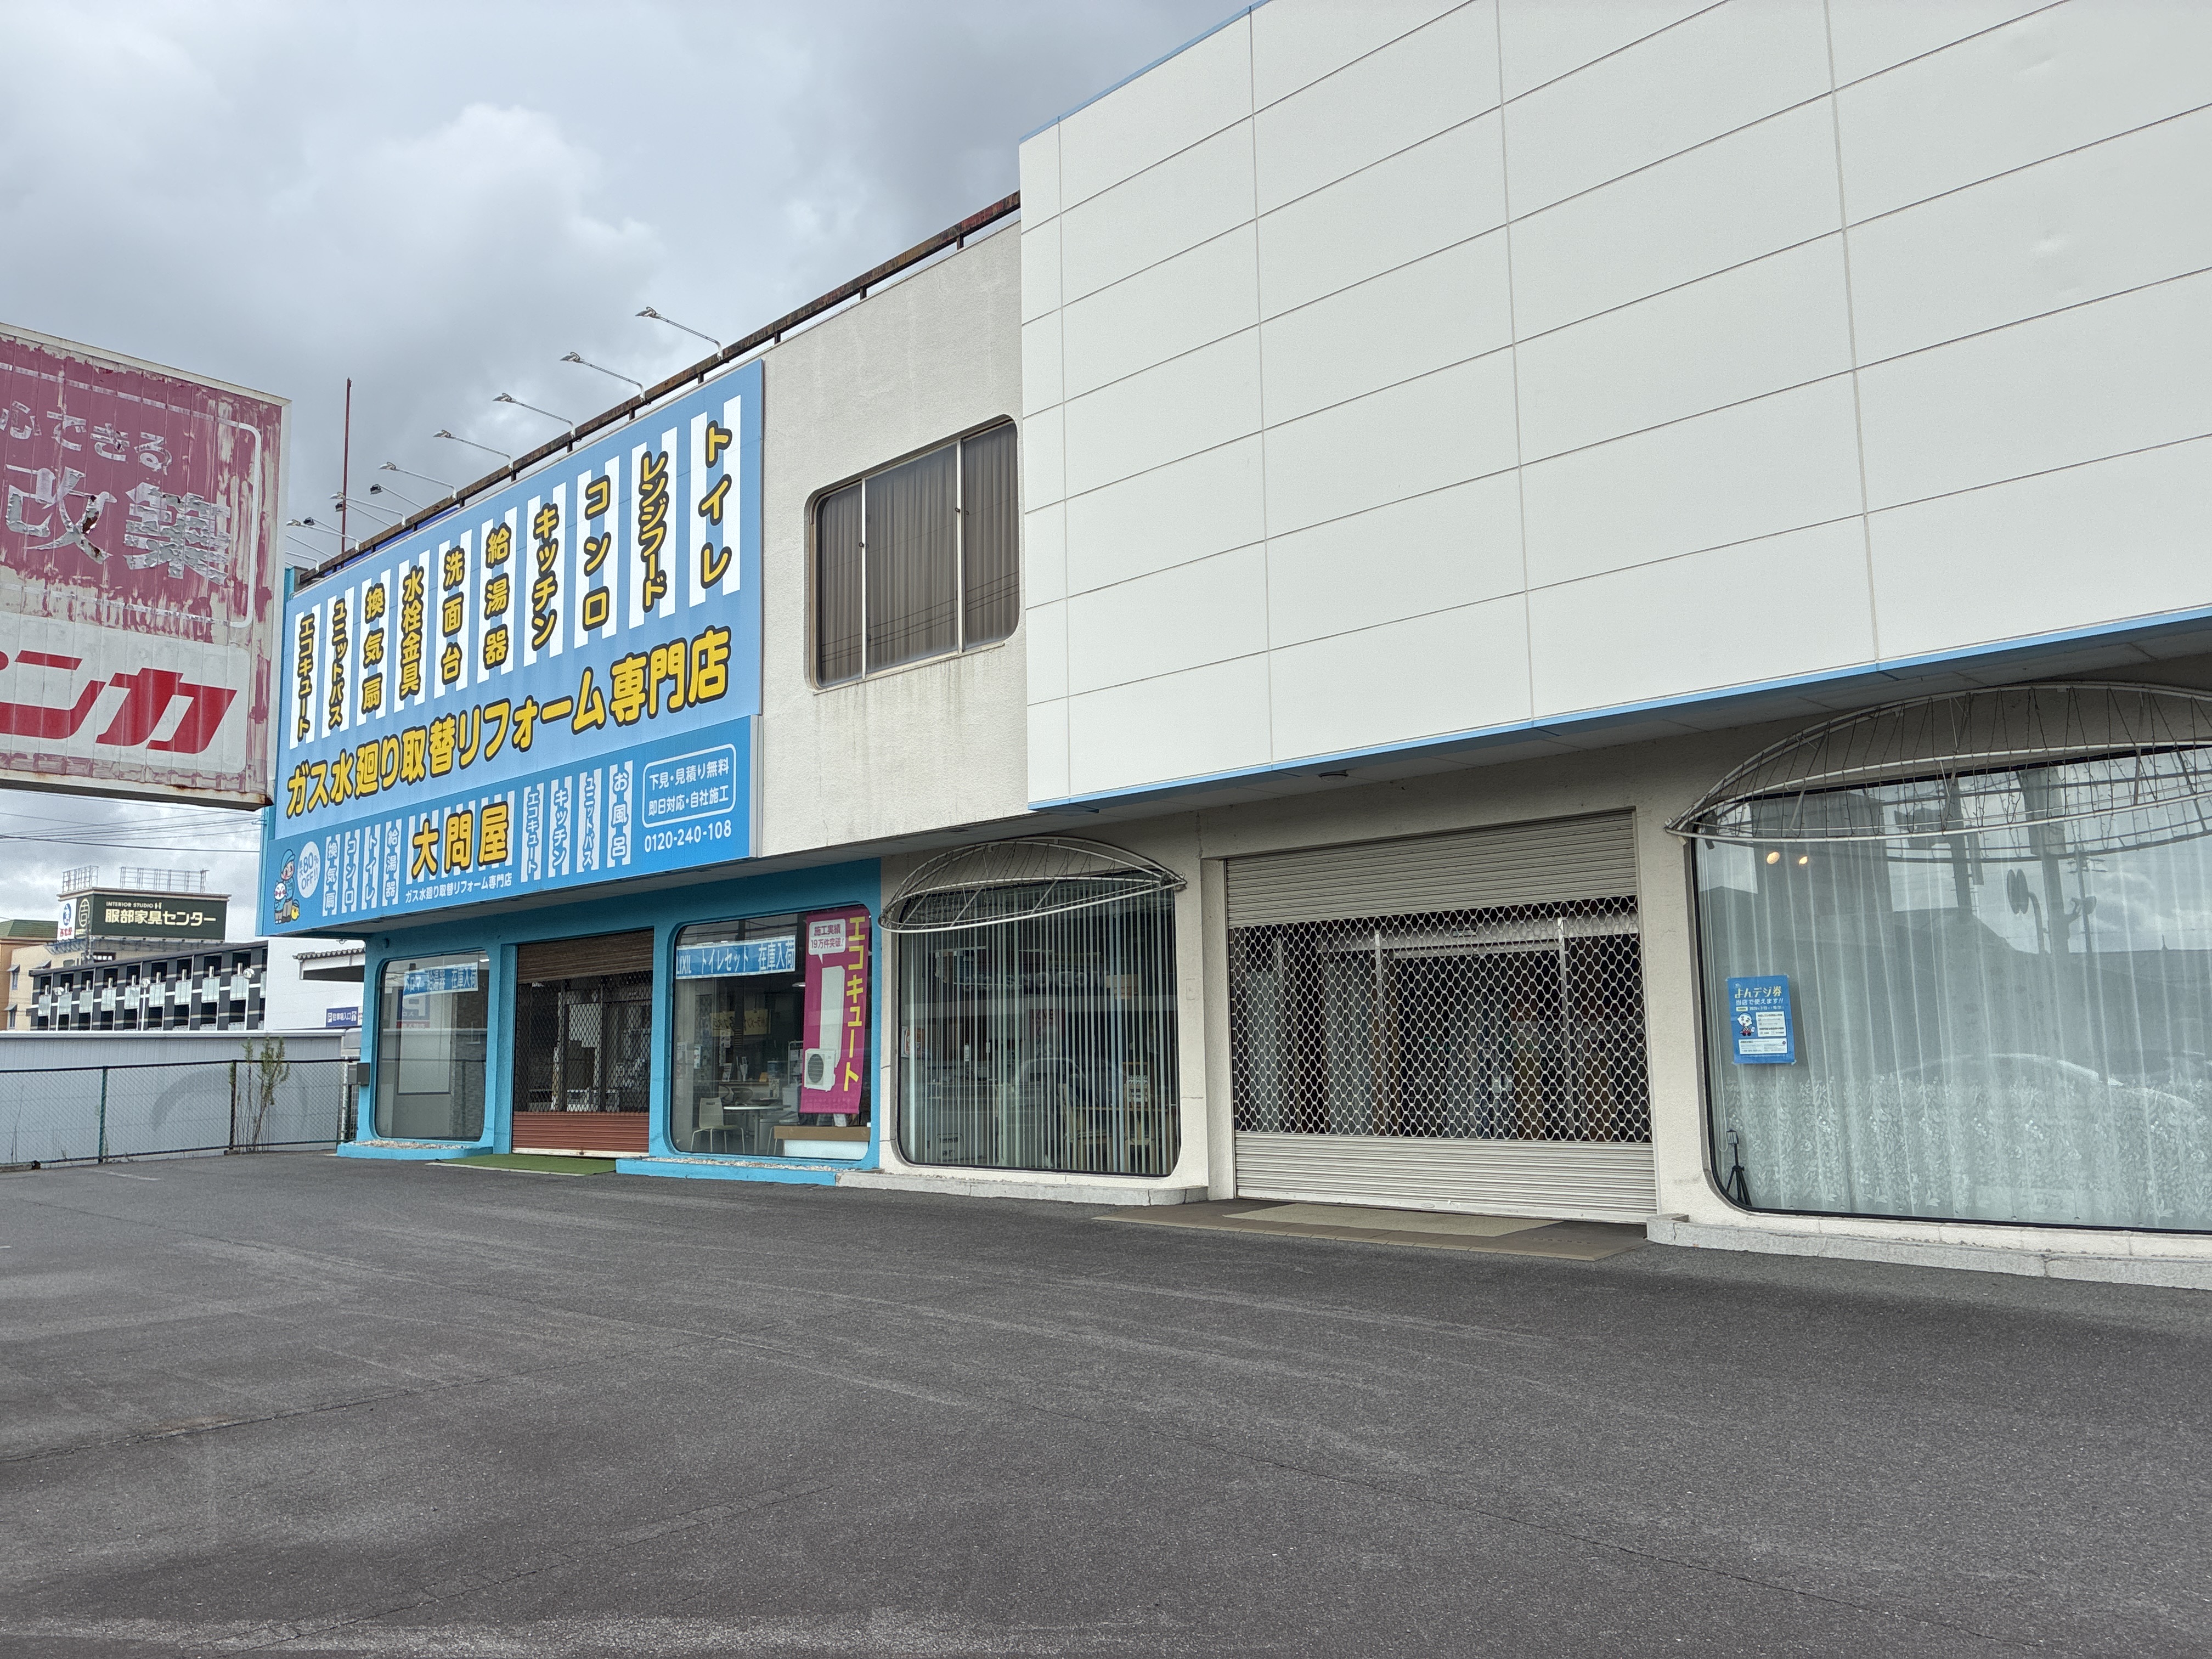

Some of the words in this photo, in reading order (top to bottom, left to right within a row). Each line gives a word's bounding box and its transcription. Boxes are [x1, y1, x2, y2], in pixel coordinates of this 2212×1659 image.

[639, 452, 668, 612] レンジフード
[699, 421, 732, 588] トイレ
[532, 503, 558, 650] キッチン
[583, 476, 611, 630] コンロ
[400, 566, 424, 699] 水栓金具
[442, 546, 464, 684] 洗面台
[484, 523, 511, 669] 給湯器
[298, 614, 314, 741] エコキュート
[329, 599, 347, 729] ユニットバス
[362, 584, 385, 713] 換気扇
[0, 650, 237, 754] ンカ
[286, 625, 731, 818] ガス水廻り取替リフォーム専門店
[612, 772, 629, 857] お風呂
[648, 785, 729, 816] 即日対応・自社施工
[649, 757, 730, 791] 下見・見積り無料
[386, 829, 398, 898] 給湯器
[411, 801, 509, 879] 大問屋
[527, 792, 539, 873] エコキュート
[552, 789, 569, 866] キッチン
[583, 777, 595, 865] ユニットバス
[644, 820, 731, 853] 0120-240-108
[325, 842, 337, 909] 換気扇
[346, 840, 357, 904] コンロ
[366, 834, 377, 900] トイレ
[105, 909, 216, 927] 服部家具センター
[676, 955, 692, 974] LIXIL
[702, 945, 749, 975] トイレセット
[758, 939, 795, 972] 在庫入荷
[814, 924, 841, 936] 施工実績
[844, 916, 866, 1091] エコキュート
[1735, 986, 1782, 998] よんデジ券
